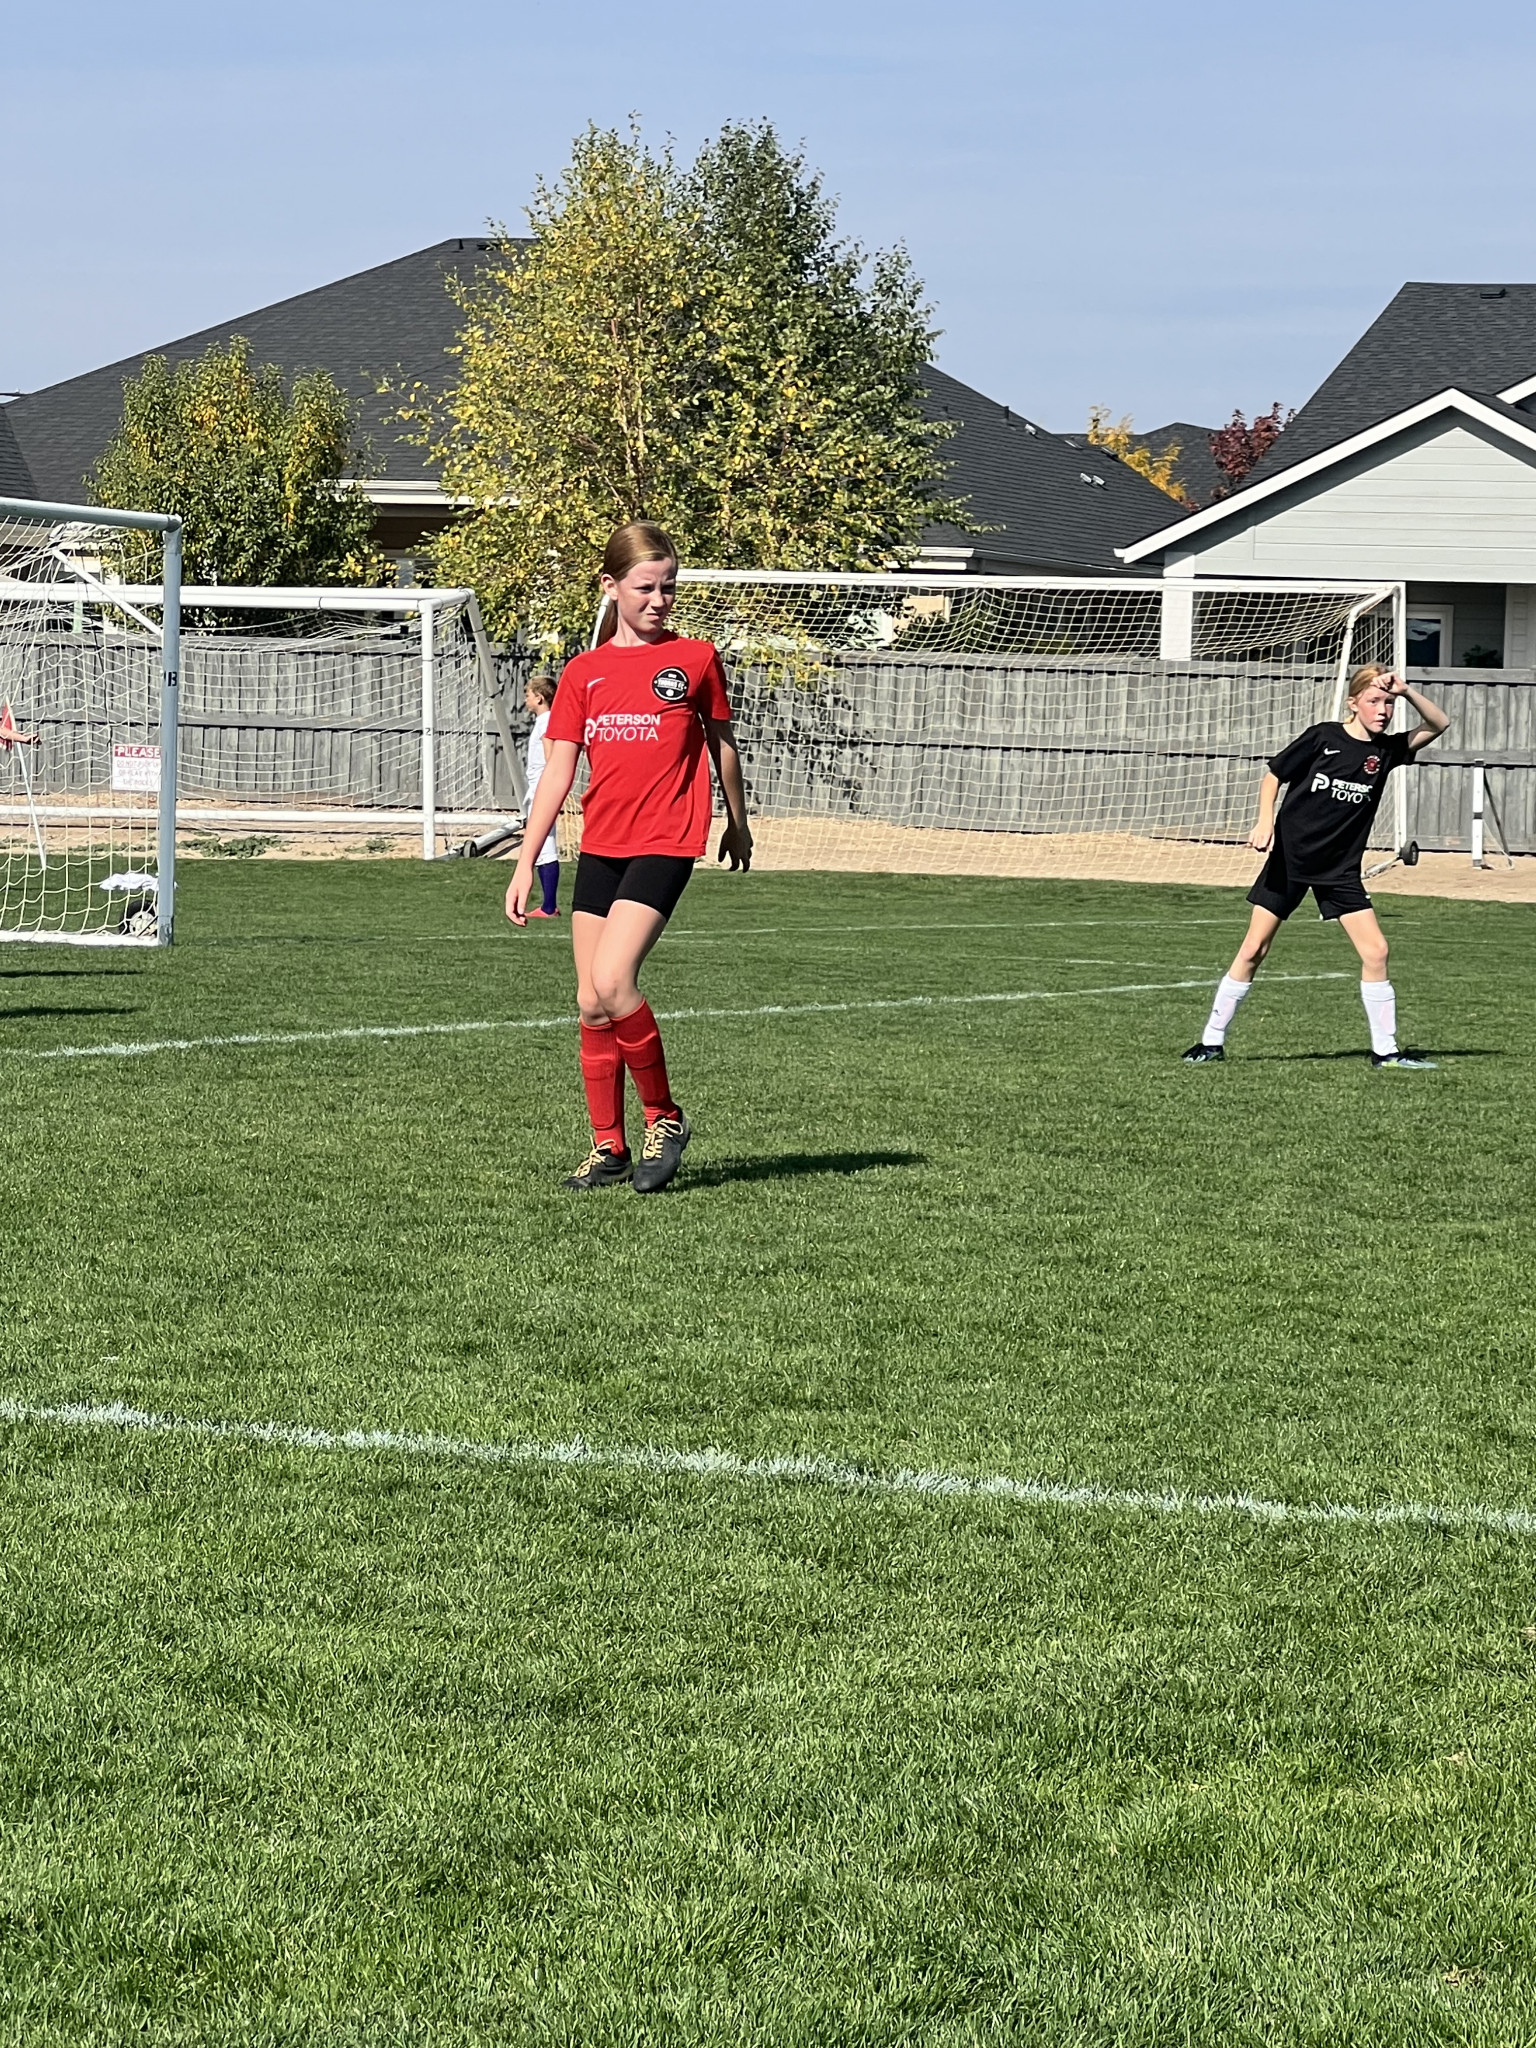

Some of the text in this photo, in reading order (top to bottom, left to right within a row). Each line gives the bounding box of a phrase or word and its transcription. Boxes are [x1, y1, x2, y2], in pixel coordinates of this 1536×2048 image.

[596, 713, 661, 726] PETERSON
[597, 726, 659, 742] TOYOTA
[117, 746, 161, 758] PLEASE
[1331, 787, 1371, 804] TOYO
